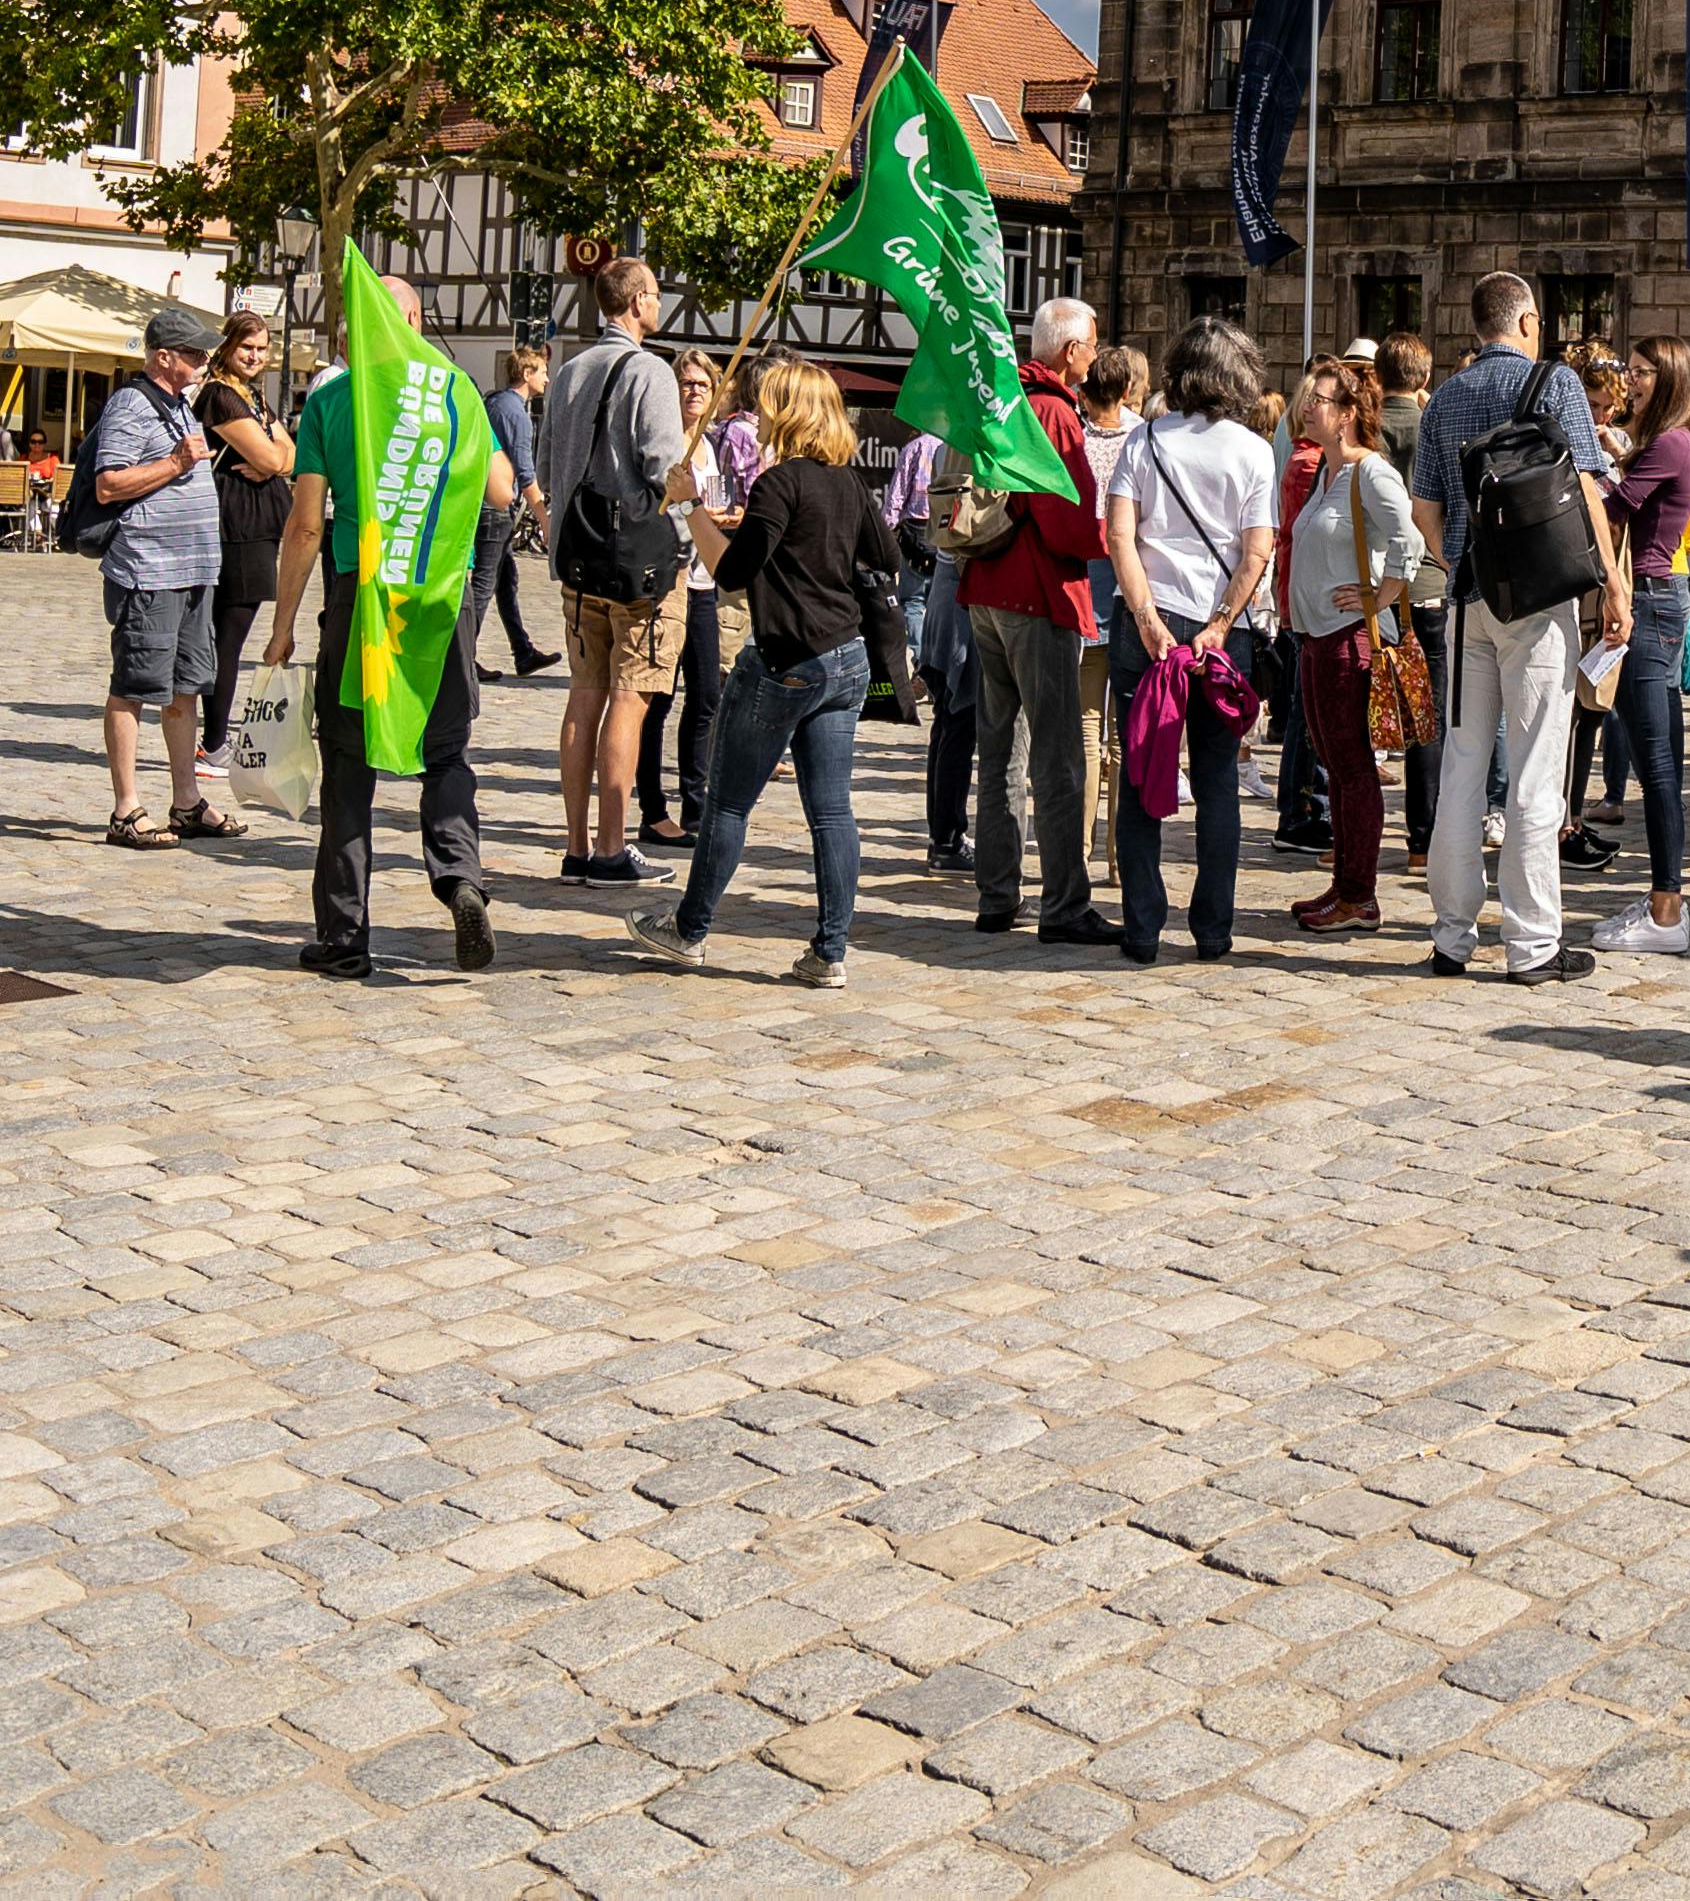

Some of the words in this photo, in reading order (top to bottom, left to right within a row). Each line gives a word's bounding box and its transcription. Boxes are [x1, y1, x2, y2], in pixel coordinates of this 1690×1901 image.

[883, 236, 960, 326] Grüne
[951, 328, 1022, 426] Jugend
[241, 732, 254, 749] A
